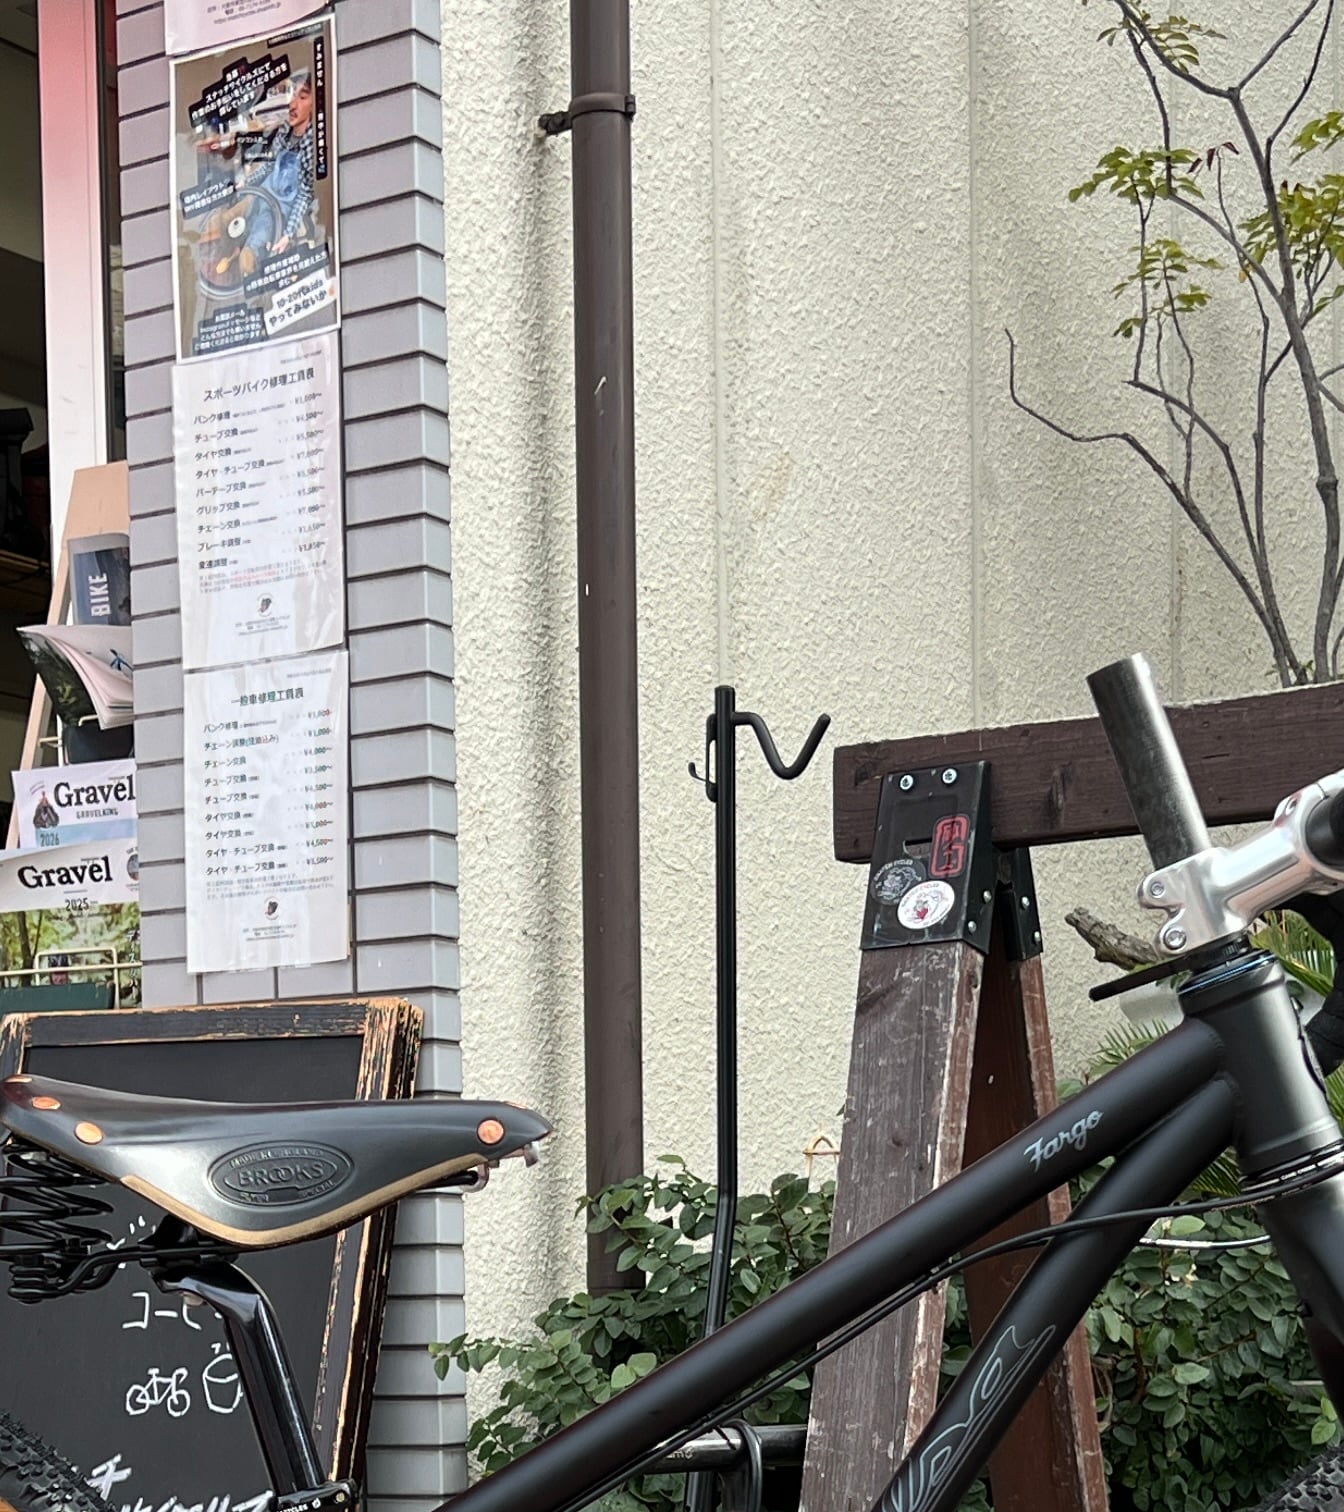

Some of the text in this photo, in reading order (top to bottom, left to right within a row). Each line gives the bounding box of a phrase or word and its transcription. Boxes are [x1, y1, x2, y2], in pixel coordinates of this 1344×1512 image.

[89, 571, 110, 617] BIKE
[53, 773, 136, 808] Gravel
[17, 855, 113, 889] Gravel
[65, 897, 89, 912] 2025
[1024, 1106, 1103, 1172] Fargo
[238, 1161, 325, 1187] BROOKS
